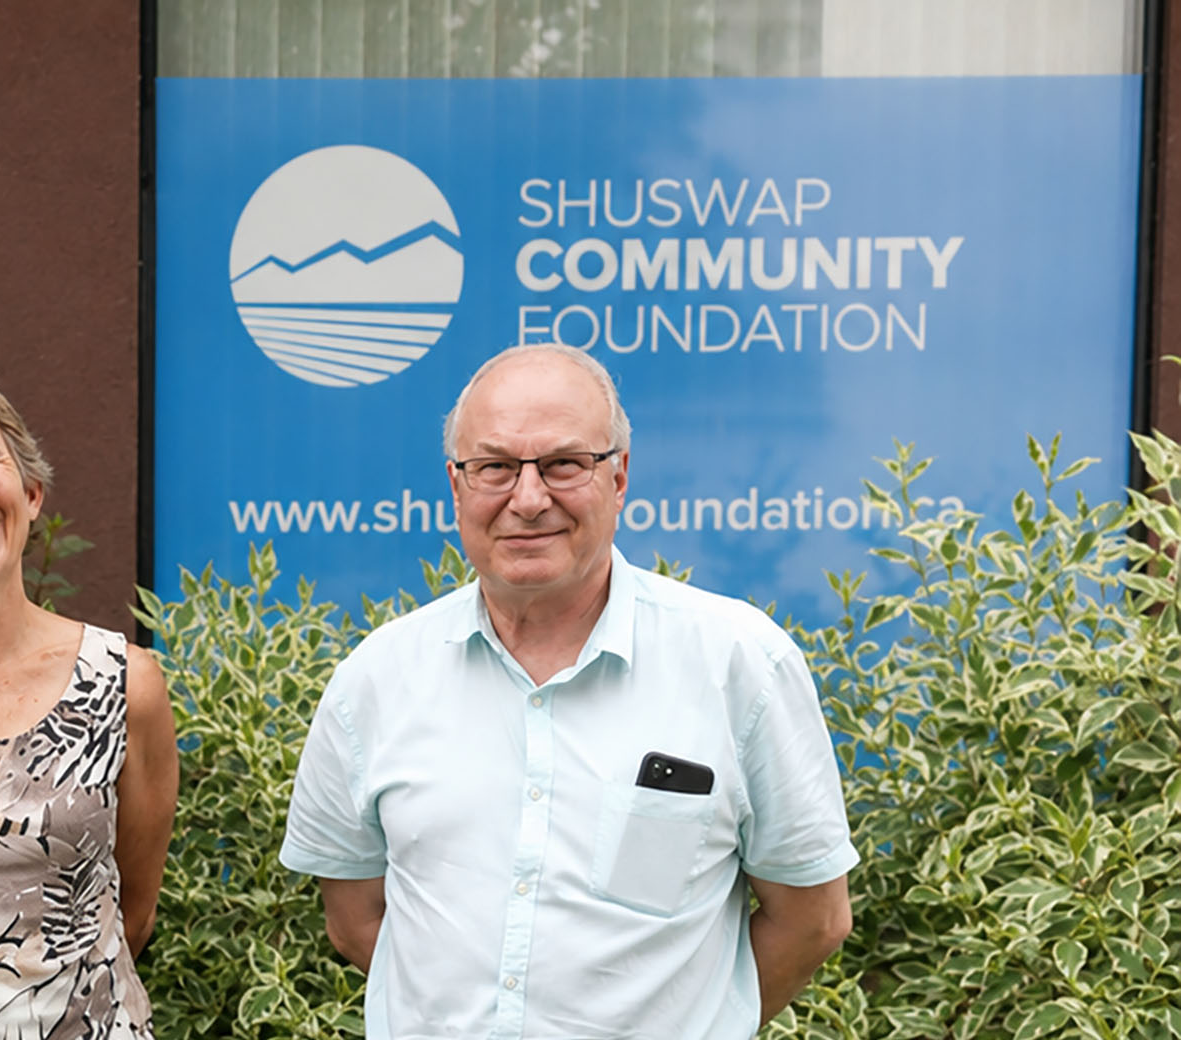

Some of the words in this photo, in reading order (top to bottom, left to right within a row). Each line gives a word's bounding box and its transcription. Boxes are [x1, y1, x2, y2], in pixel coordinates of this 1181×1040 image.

[518, 177, 832, 228] SHUSWAP
[515, 236, 965, 292] COMMUNITY
[518, 302, 927, 353] FOUNDATION
[228, 486, 967, 534] www.shuoundation.ca
